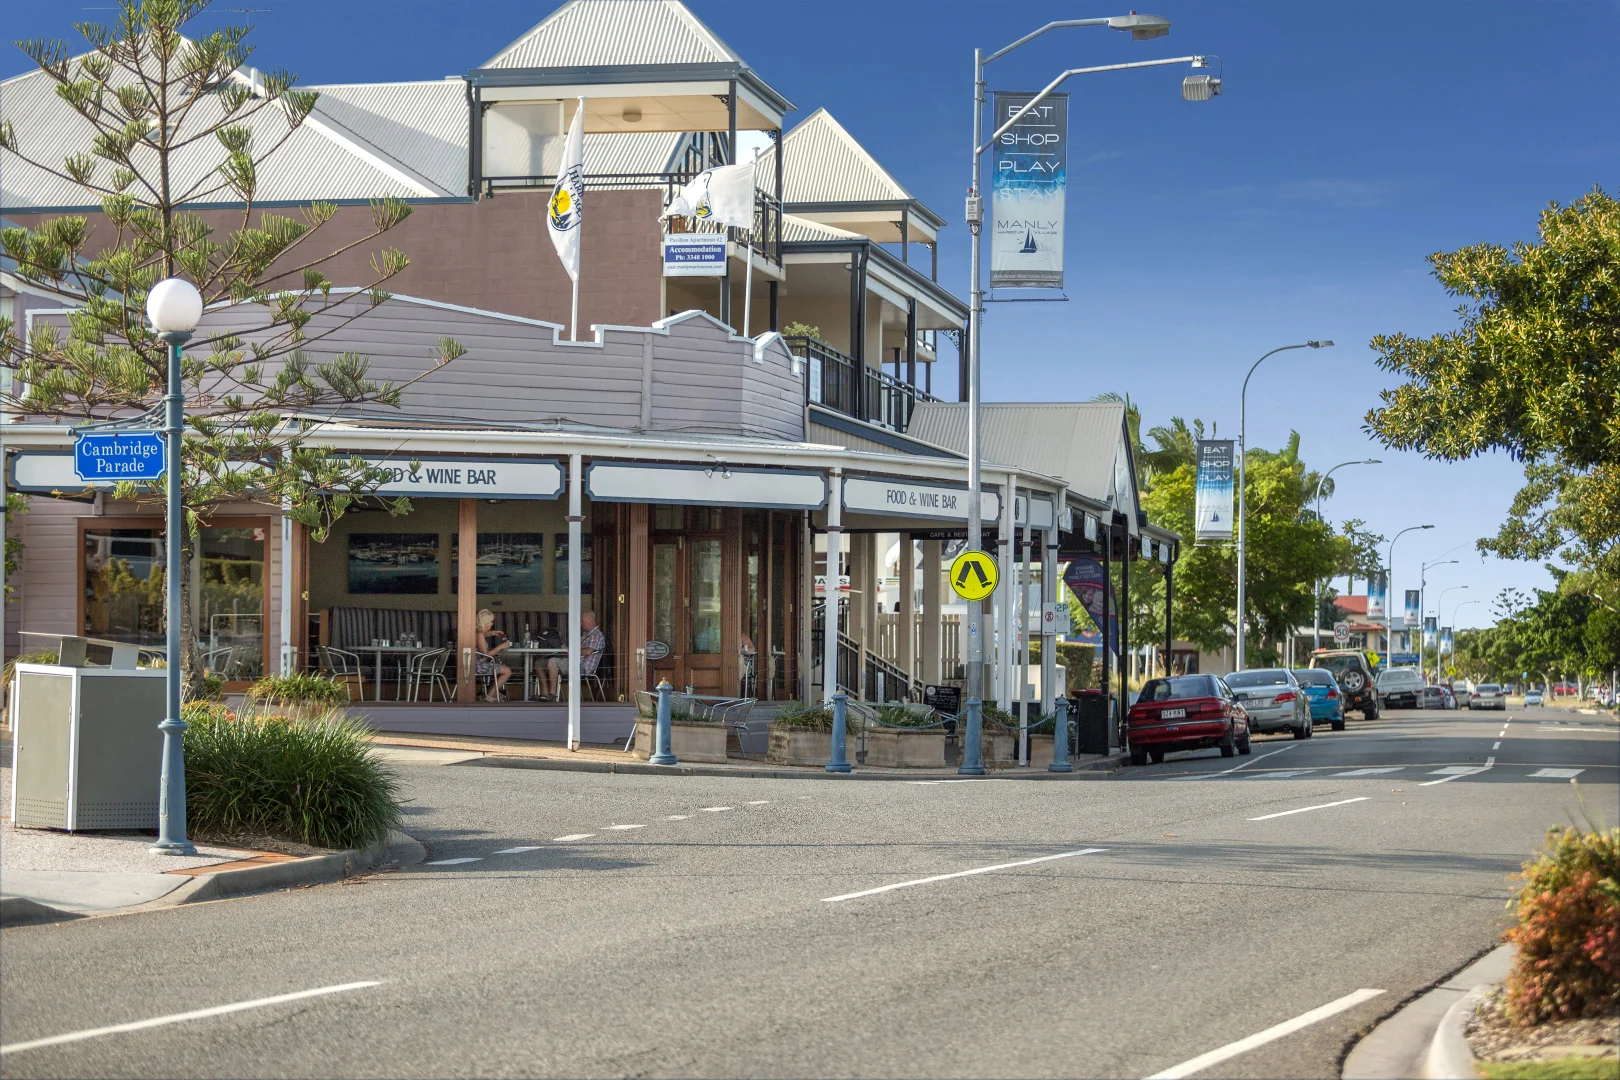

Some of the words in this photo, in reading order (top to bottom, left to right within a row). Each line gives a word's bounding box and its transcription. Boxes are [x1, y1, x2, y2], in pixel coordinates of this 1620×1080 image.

[1008, 105, 1053, 118] EAT
[1000, 132, 1060, 146] SHOP
[998, 160, 1060, 173] PLAY
[1000, 187, 1058, 200] STAY
[997, 219, 1058, 230] MANLY
[669, 245, 722, 253] Accommodation
[82, 440, 158, 459] Cambridge
[1203, 446, 1227, 454] EAT
[96, 457, 145, 474] Parade
[1200, 460, 1231, 468] SHOP
[408, 470, 423, 484] &
[426, 468, 461, 485] WINE
[467, 469, 497, 486] BAR
[1200, 474, 1231, 482] PLAY
[886, 489, 907, 505] FOOD
[909, 492, 917, 506] &
[919, 492, 939, 509] WINE
[942, 494, 957, 510] BAR
[1056, 603, 1069, 612] 2P
[1336, 627, 1348, 637] 50
